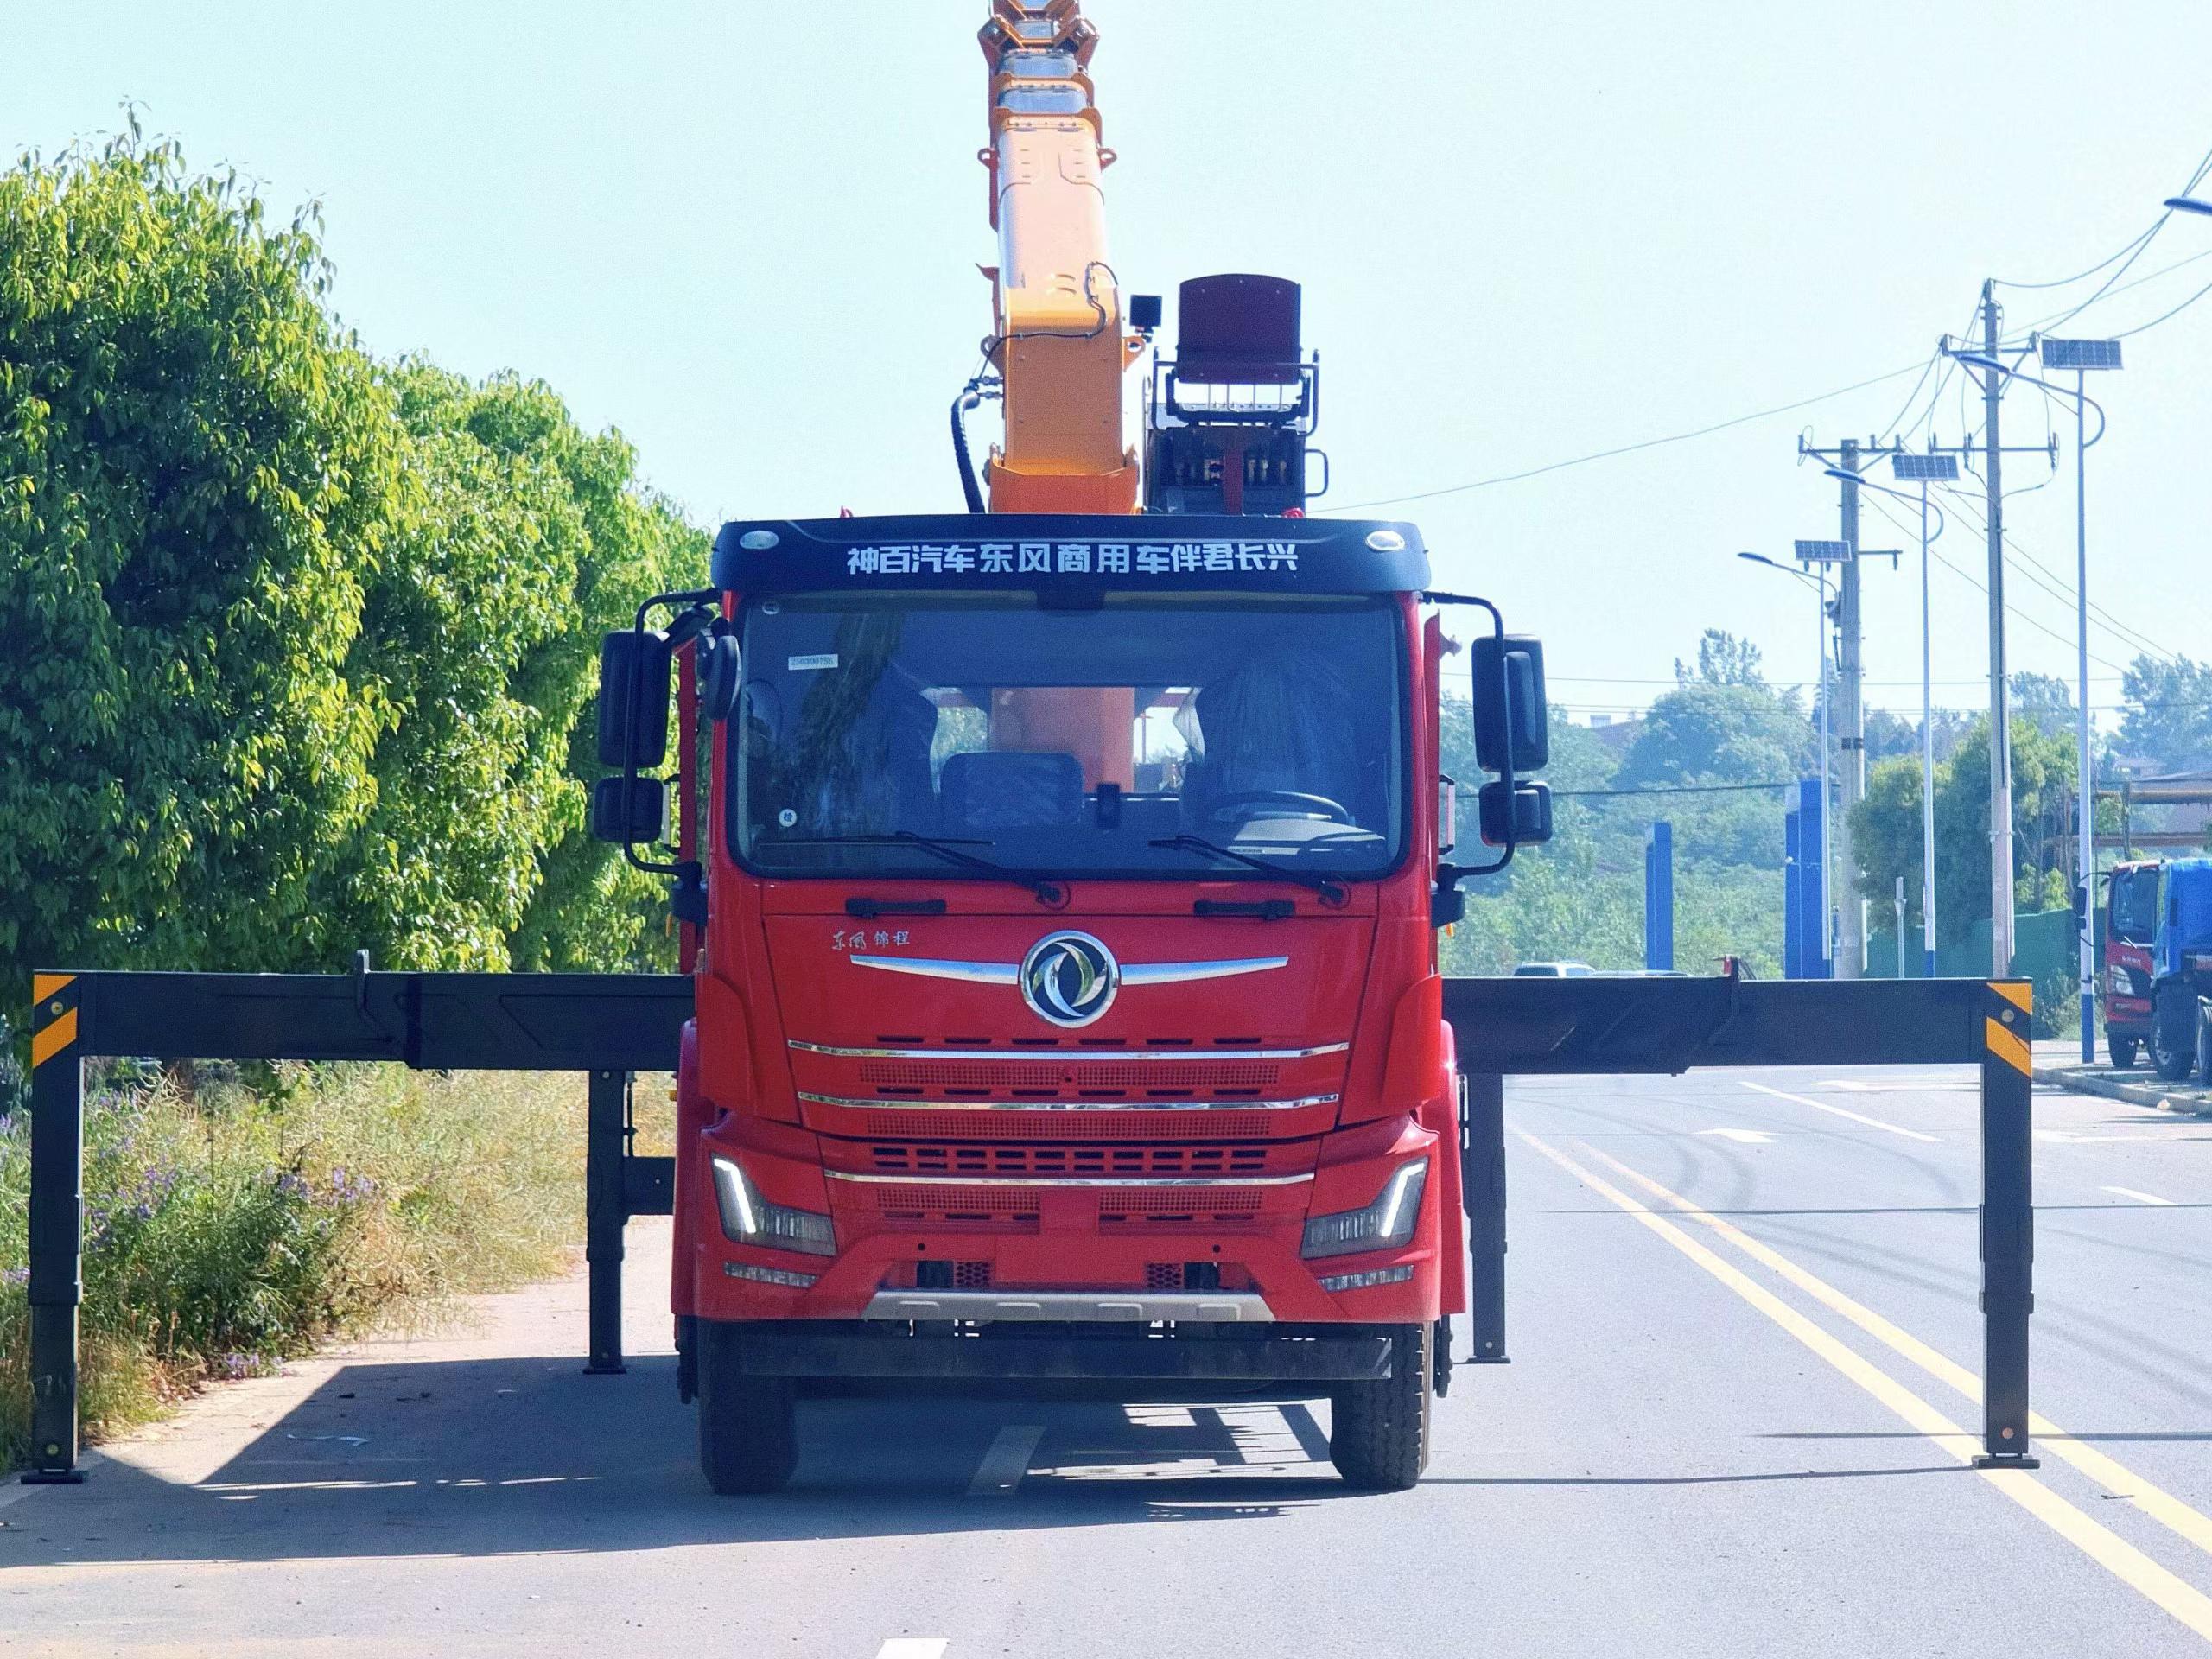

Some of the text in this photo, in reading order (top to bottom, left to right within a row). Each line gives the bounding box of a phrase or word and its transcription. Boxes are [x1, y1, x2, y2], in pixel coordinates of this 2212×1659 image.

[847, 543, 1299, 575] 神百汽车东风商用车伴君长兴
